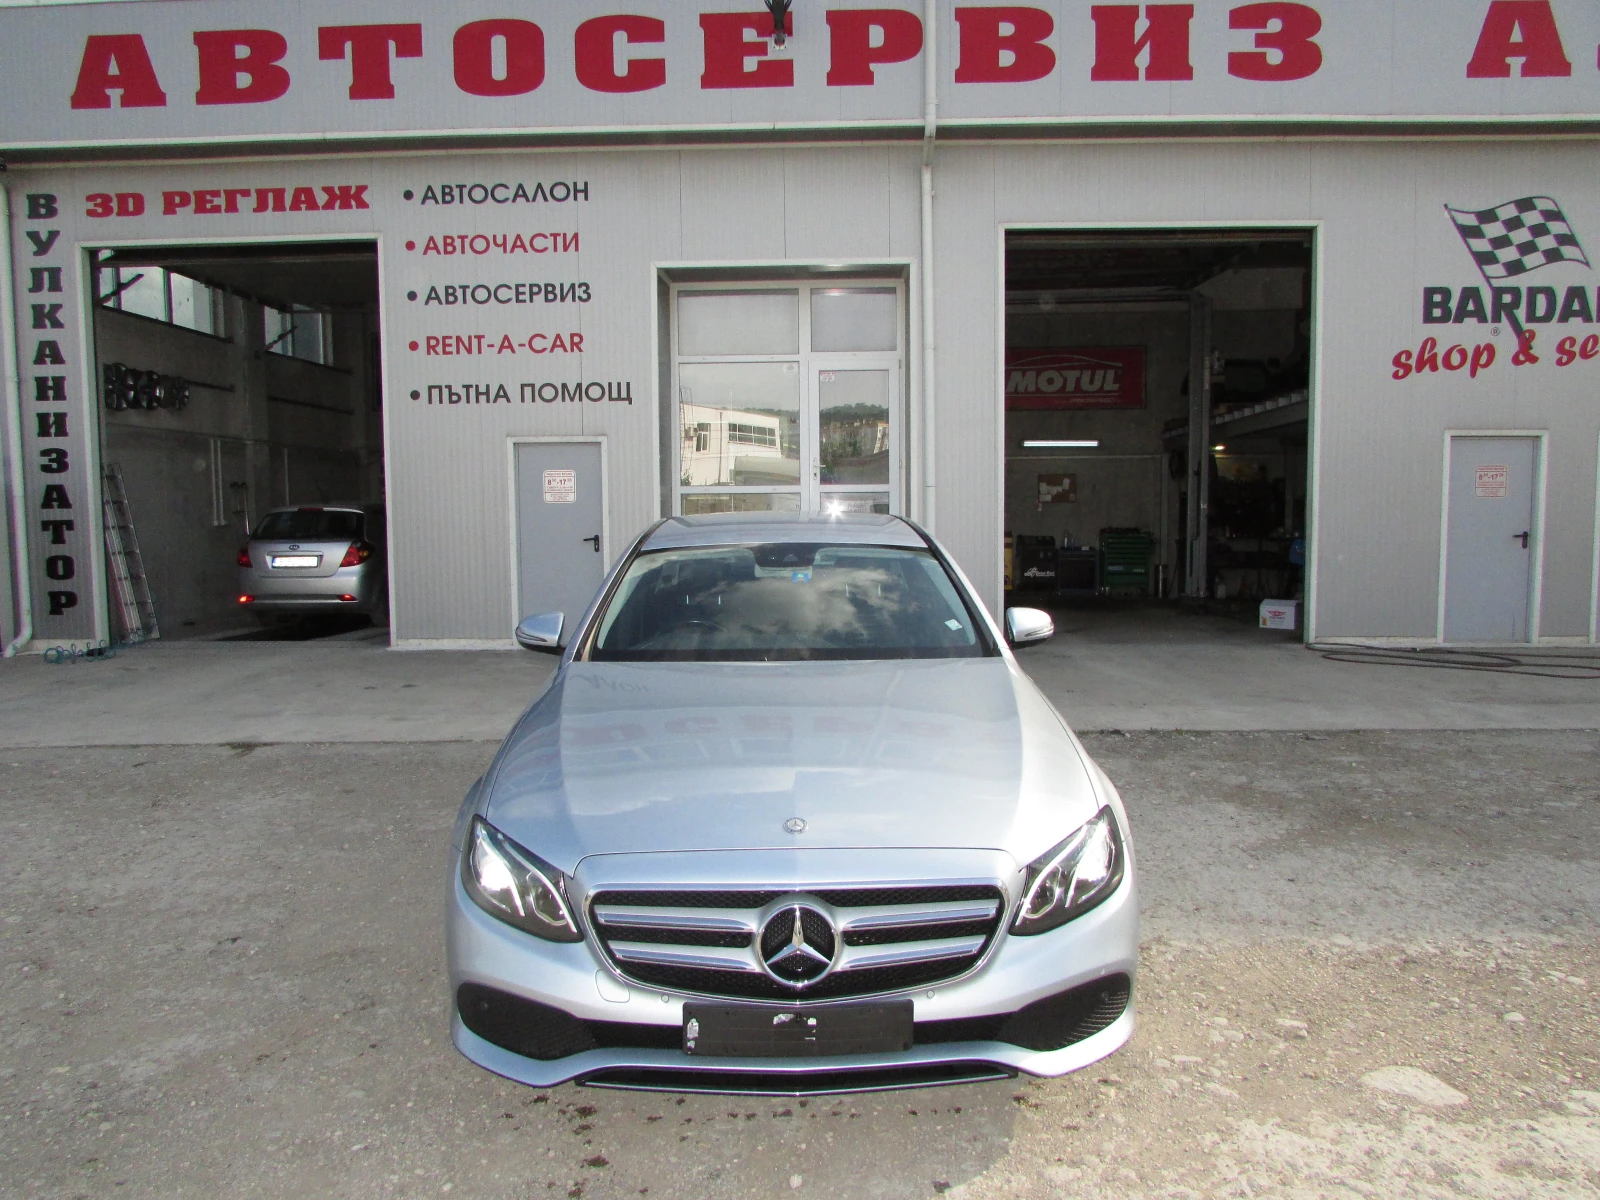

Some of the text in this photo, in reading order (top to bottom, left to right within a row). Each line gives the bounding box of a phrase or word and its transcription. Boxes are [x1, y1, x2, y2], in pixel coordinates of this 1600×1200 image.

[72, 1, 1600, 109] АВТОСЕРВИЗ А
[86, 185, 370, 219] 3D РЕГЛАЖ
[420, 181, 590, 206] АВТОСАЛОН
[422, 232, 580, 257] АВТОЧАСТИ
[424, 282, 592, 307] АВТОСЕРВИЗ
[1422, 286, 1600, 324] BARDA
[426, 332, 585, 356] RENT-A-CAR
[1391, 337, 1496, 381] shop
[1511, 329, 1540, 367] &
[427, 381, 633, 406] ПЪТНА ПОМОЩ
[1006, 369, 1121, 393] MOTUL
[26, 193, 79, 616] ВУЛКАНИЗАТОР
